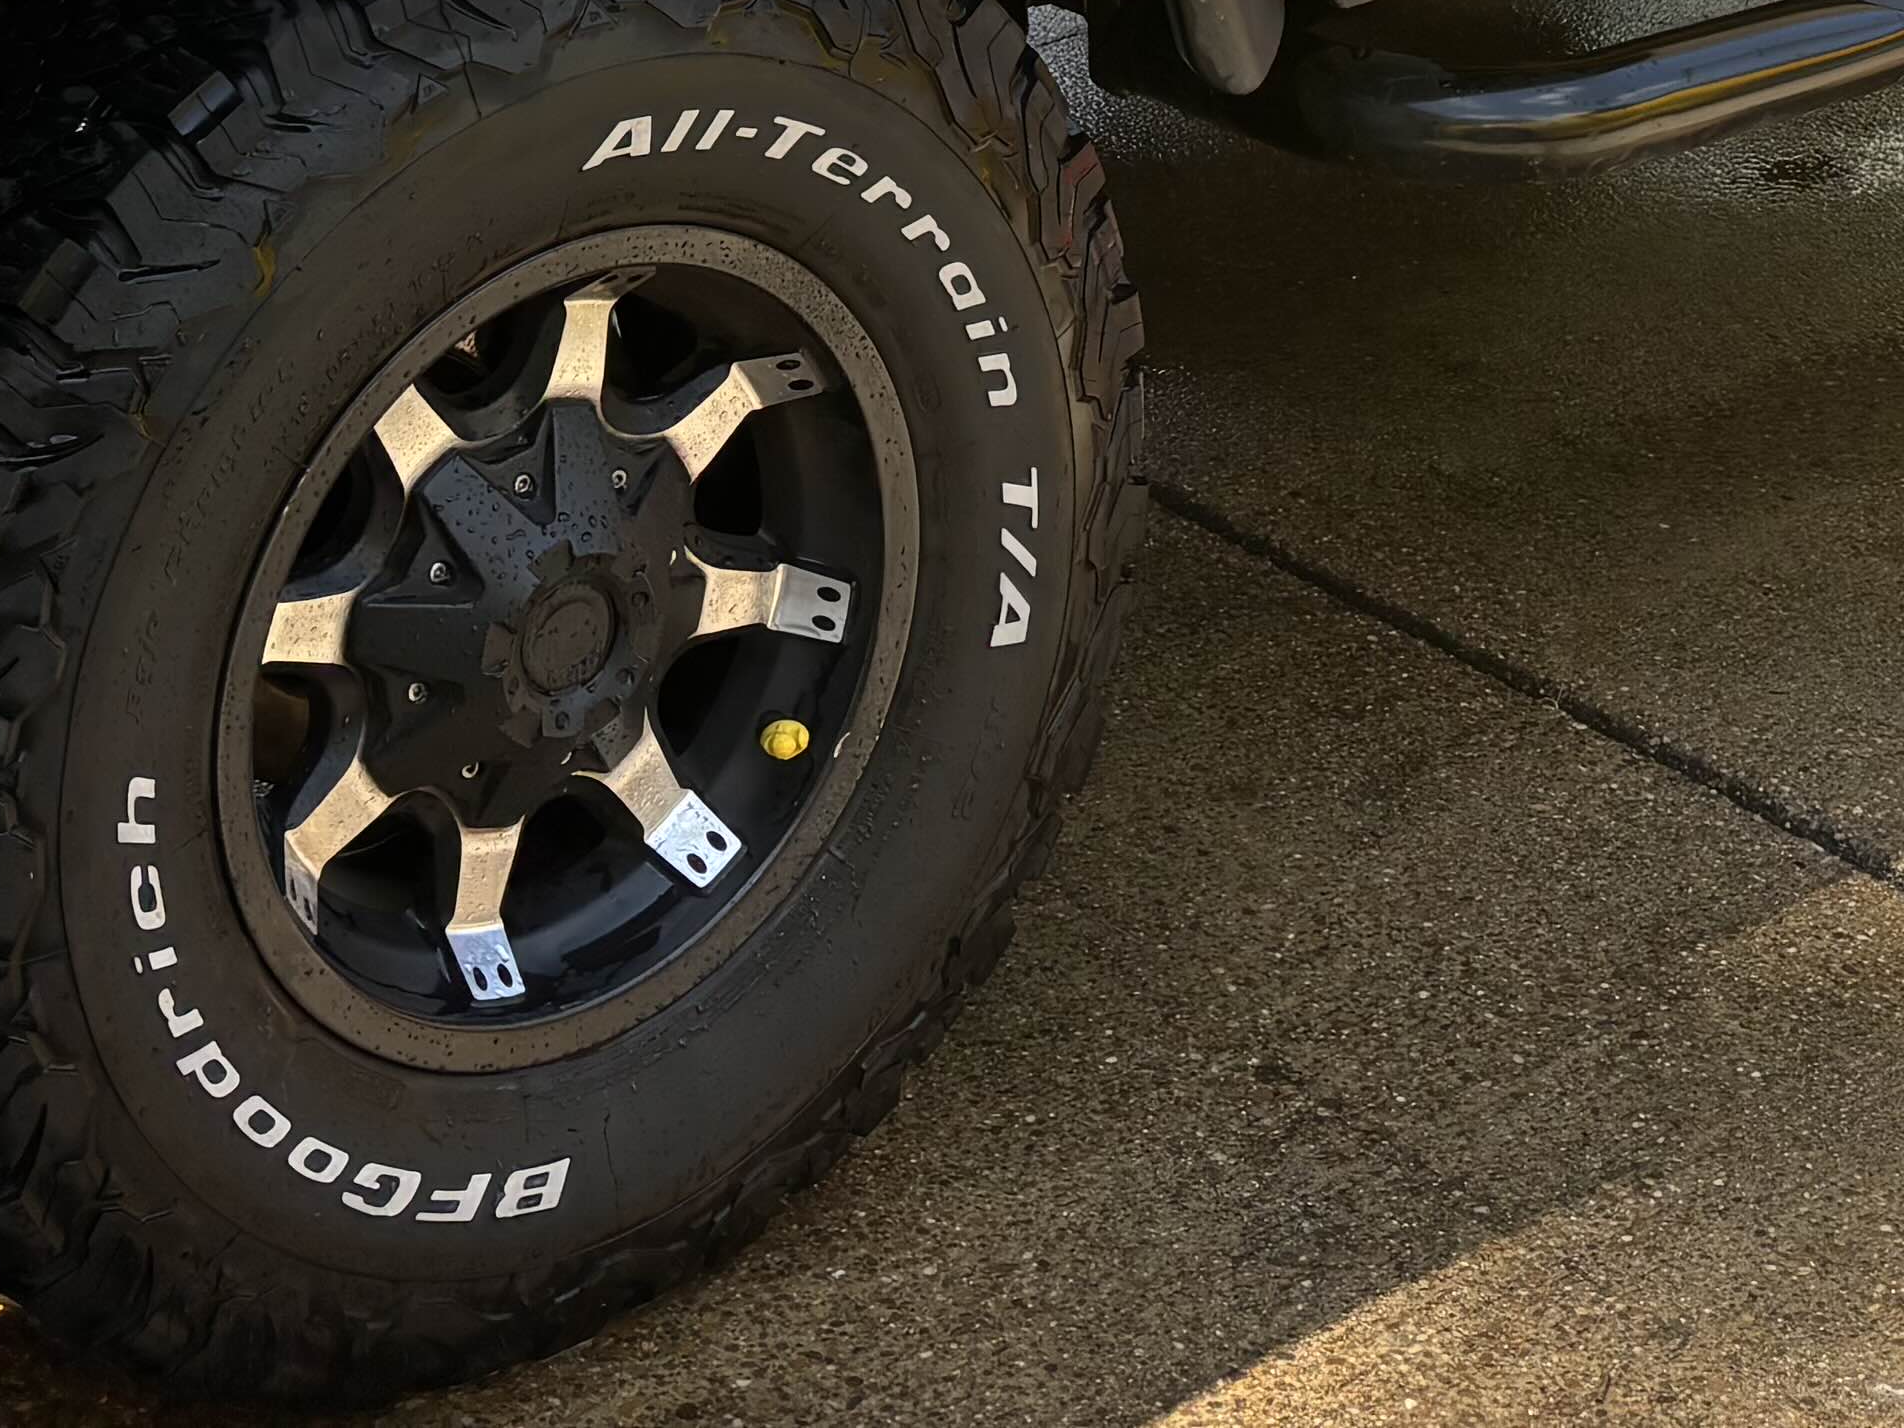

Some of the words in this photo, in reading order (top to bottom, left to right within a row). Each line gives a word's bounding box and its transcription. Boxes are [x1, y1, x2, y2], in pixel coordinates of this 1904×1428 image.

[582, 108, 1019, 408] All-Terrain
[989, 465, 1041, 649] T/A
[117, 775, 572, 1223] BFGoodrich
